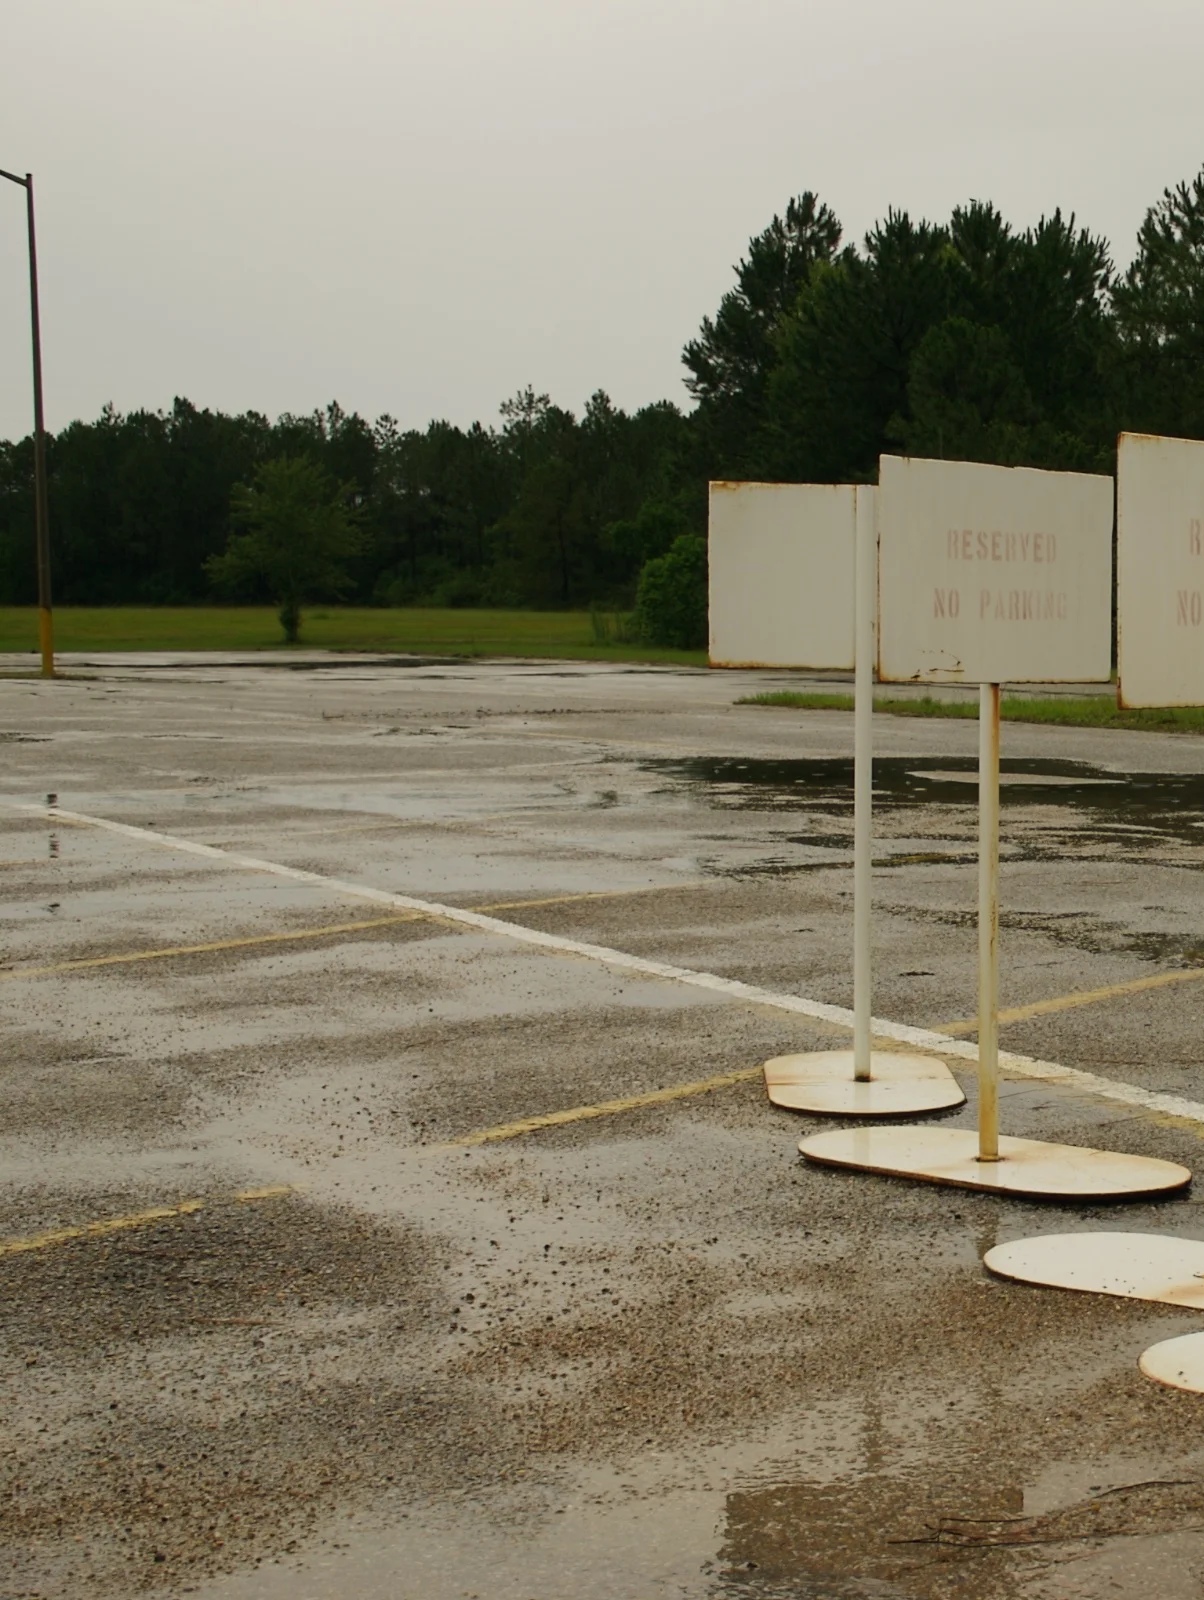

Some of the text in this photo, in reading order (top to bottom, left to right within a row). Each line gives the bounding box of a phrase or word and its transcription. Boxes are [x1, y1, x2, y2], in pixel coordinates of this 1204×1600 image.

[946, 528, 1057, 563] RESERVED
[933, 587, 1068, 621] NO PARKING
[1177, 589, 1202, 627] NO
